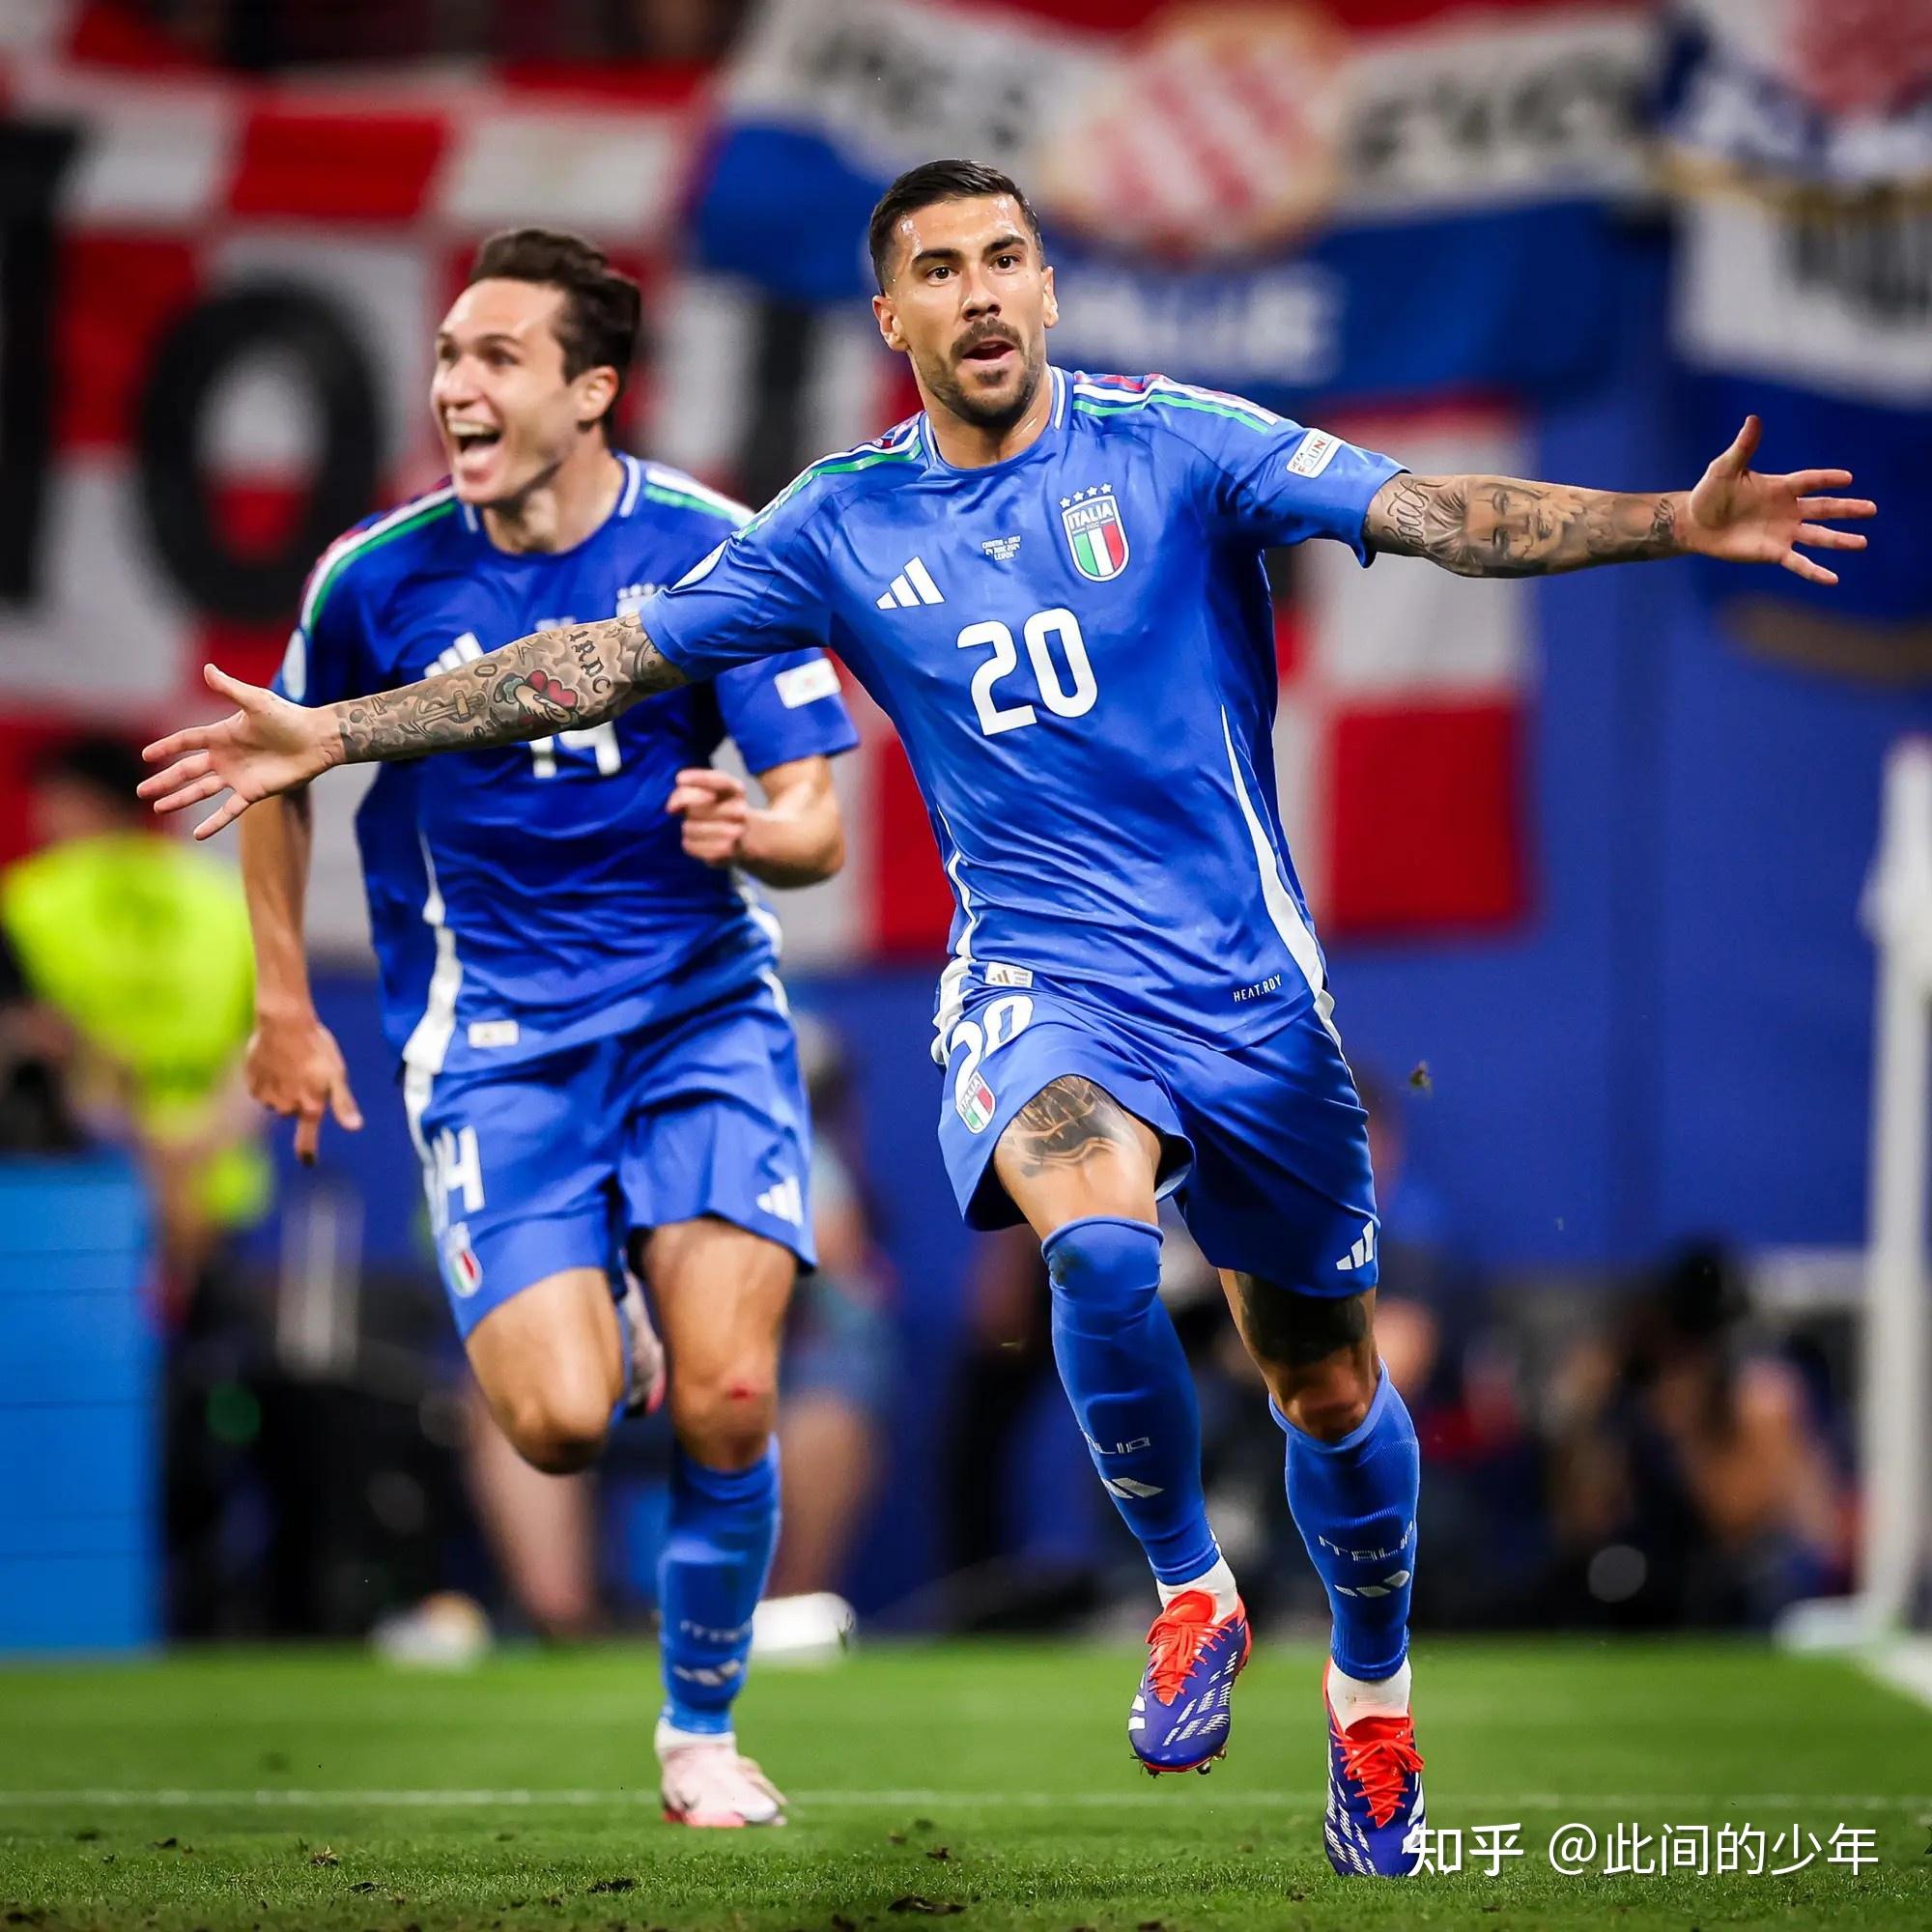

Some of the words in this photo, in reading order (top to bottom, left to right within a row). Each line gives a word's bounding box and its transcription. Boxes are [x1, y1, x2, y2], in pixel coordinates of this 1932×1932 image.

[1067, 500, 1114, 531] ITALIA
[956, 608, 1098, 736] 20
[1233, 974, 1282, 1003] HEAT.RDY
[951, 995, 1034, 1107] 20
